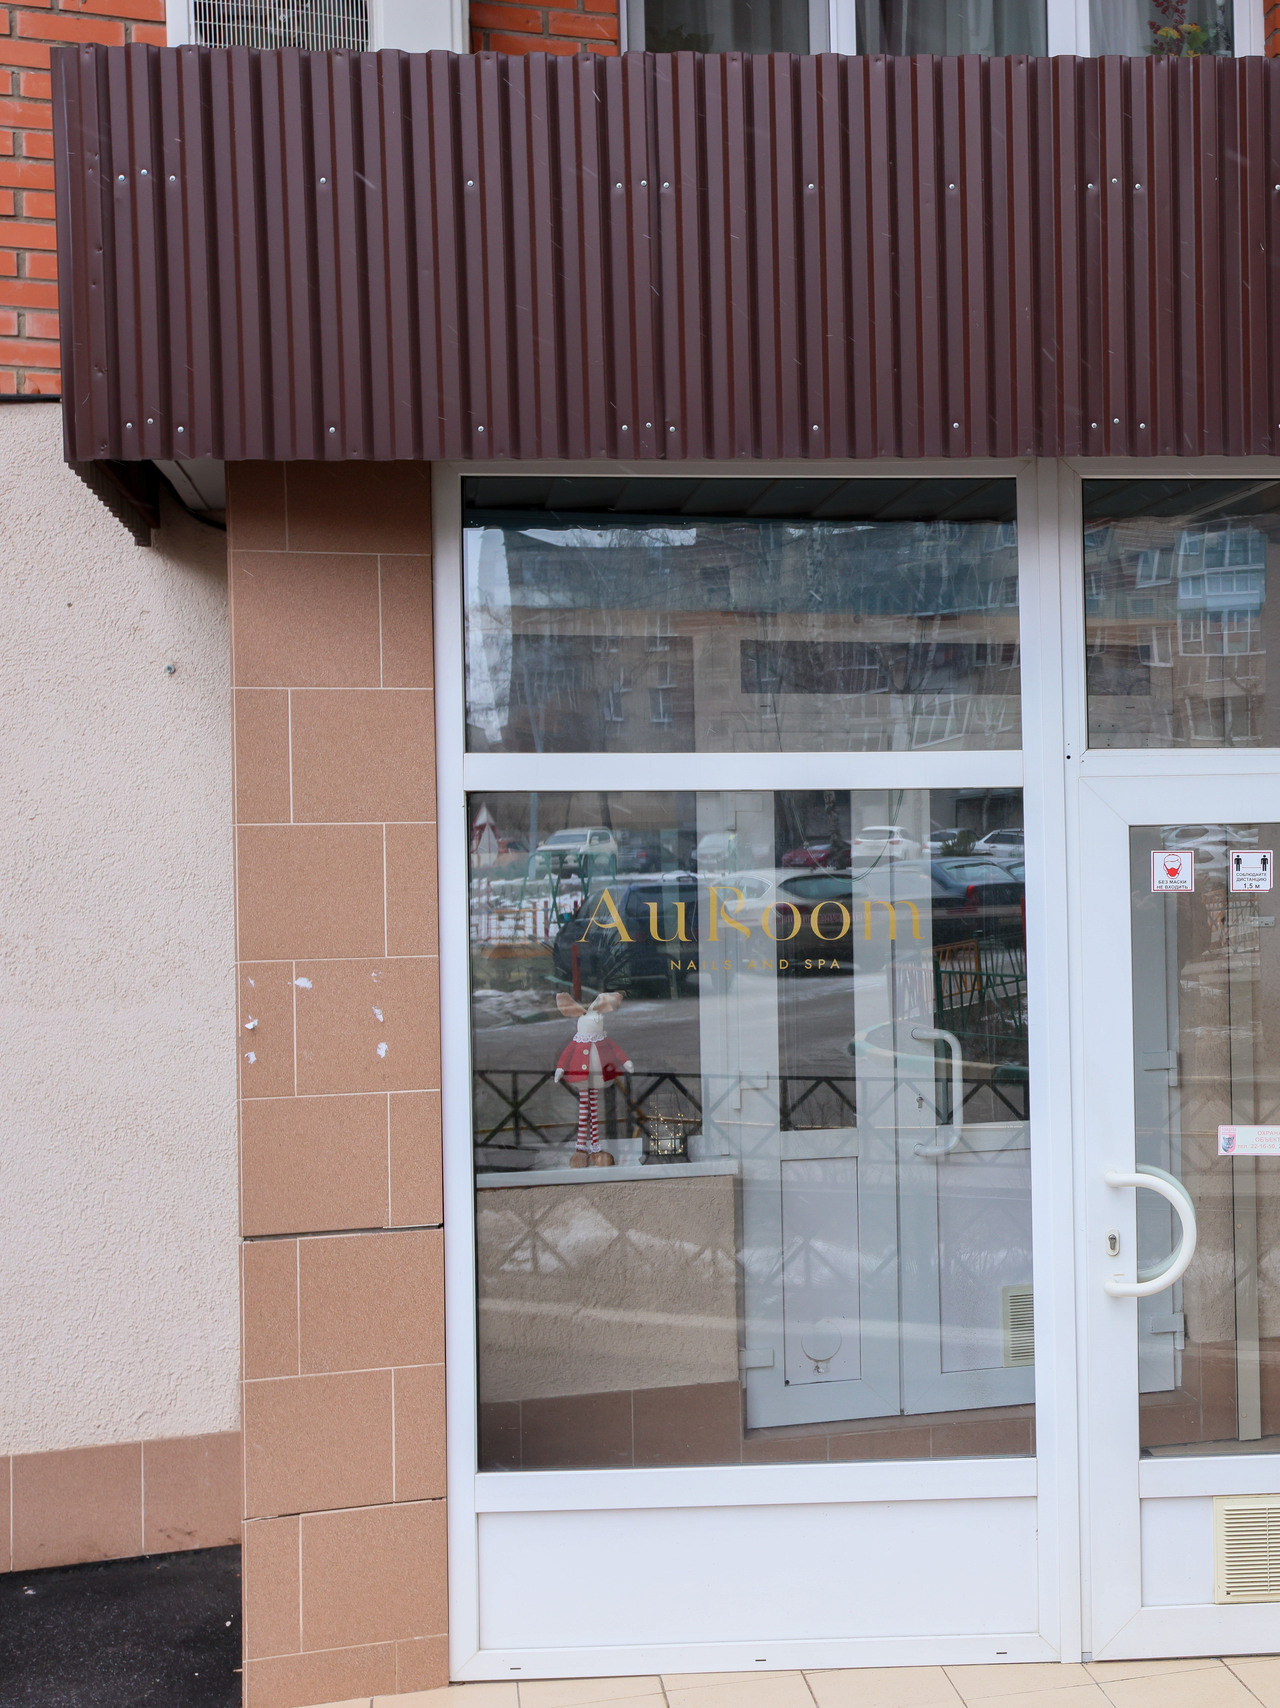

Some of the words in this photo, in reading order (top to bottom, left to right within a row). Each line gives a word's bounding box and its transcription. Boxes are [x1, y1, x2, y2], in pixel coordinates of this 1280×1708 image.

[576, 886, 925, 943] AuRoom
[670, 959, 733, 970] NAILS
[747, 959, 789, 970] AND
[804, 958, 841, 970] SPA
